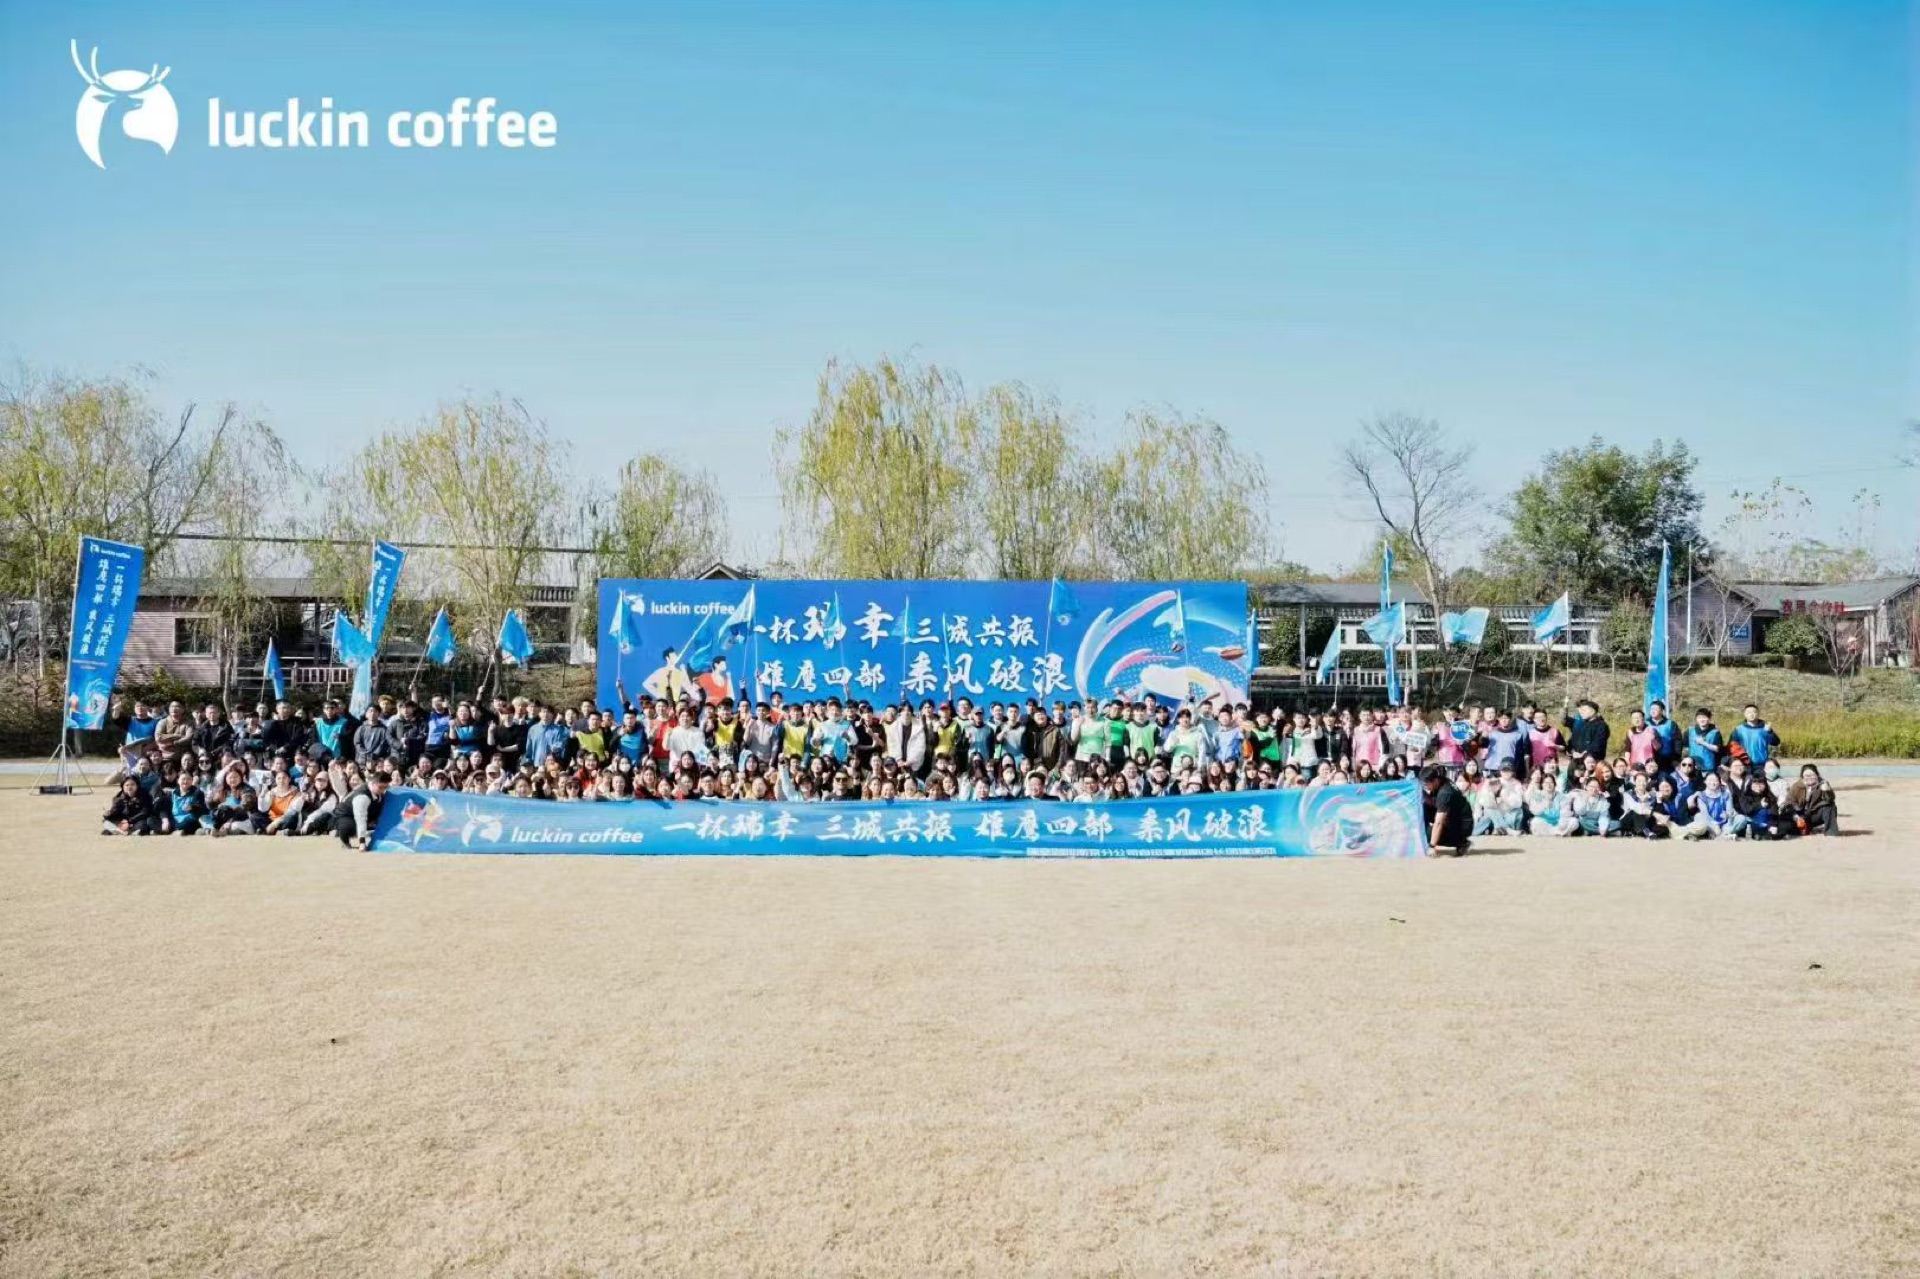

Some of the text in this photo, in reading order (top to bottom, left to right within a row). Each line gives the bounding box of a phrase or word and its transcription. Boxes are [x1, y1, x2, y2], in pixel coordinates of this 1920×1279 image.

[651, 602, 736, 615] luckin coffee
[903, 615, 1038, 648] 三城共振
[759, 651, 1072, 696] 雄鹰四部 乘风破浪
[511, 826, 644, 844] luckin coffee
[662, 804, 1272, 843] 一杯瑞幸 三城共振 雄鹰四部 乘风破浪
